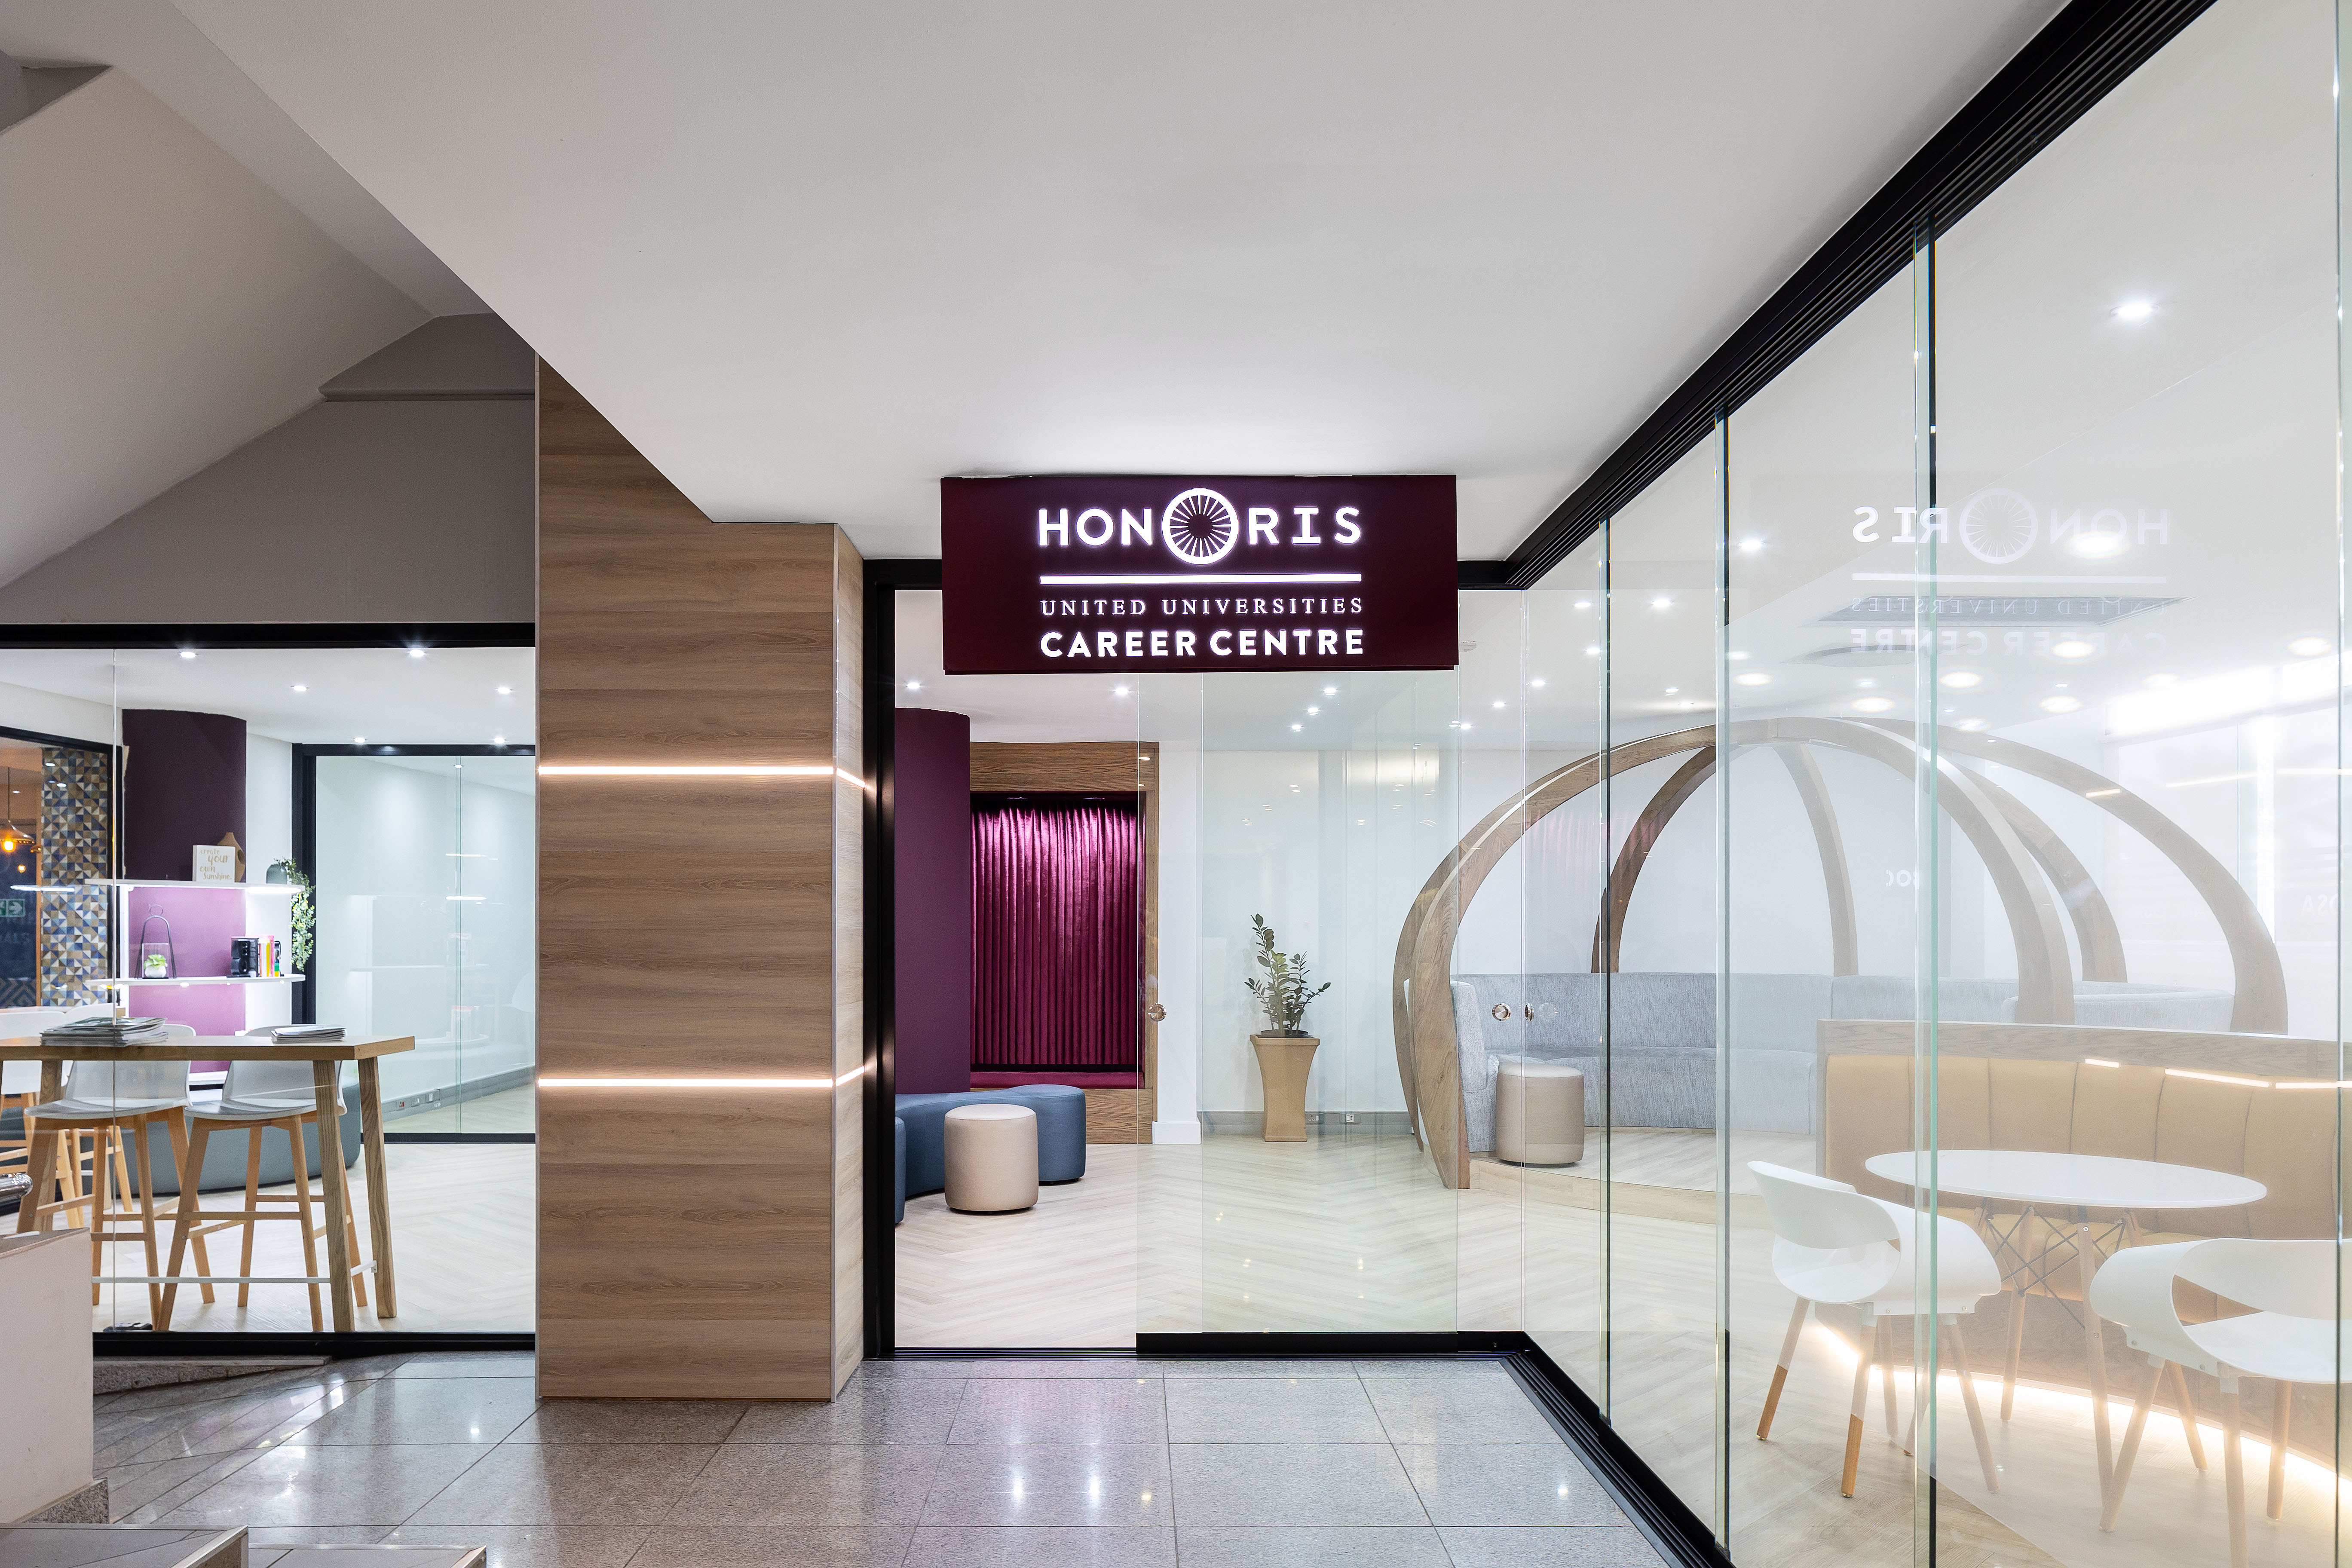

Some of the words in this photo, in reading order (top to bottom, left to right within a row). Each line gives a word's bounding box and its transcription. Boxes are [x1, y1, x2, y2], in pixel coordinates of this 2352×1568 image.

[1038, 488, 1361, 565] HONORIS
[1040, 600, 1145, 616] UNITED
[1161, 598, 1362, 615] UNIVERSITIES
[1040, 630, 1196, 658] CAREER
[1210, 629, 1363, 656] CENTRE
[208, 854, 230, 866] your
